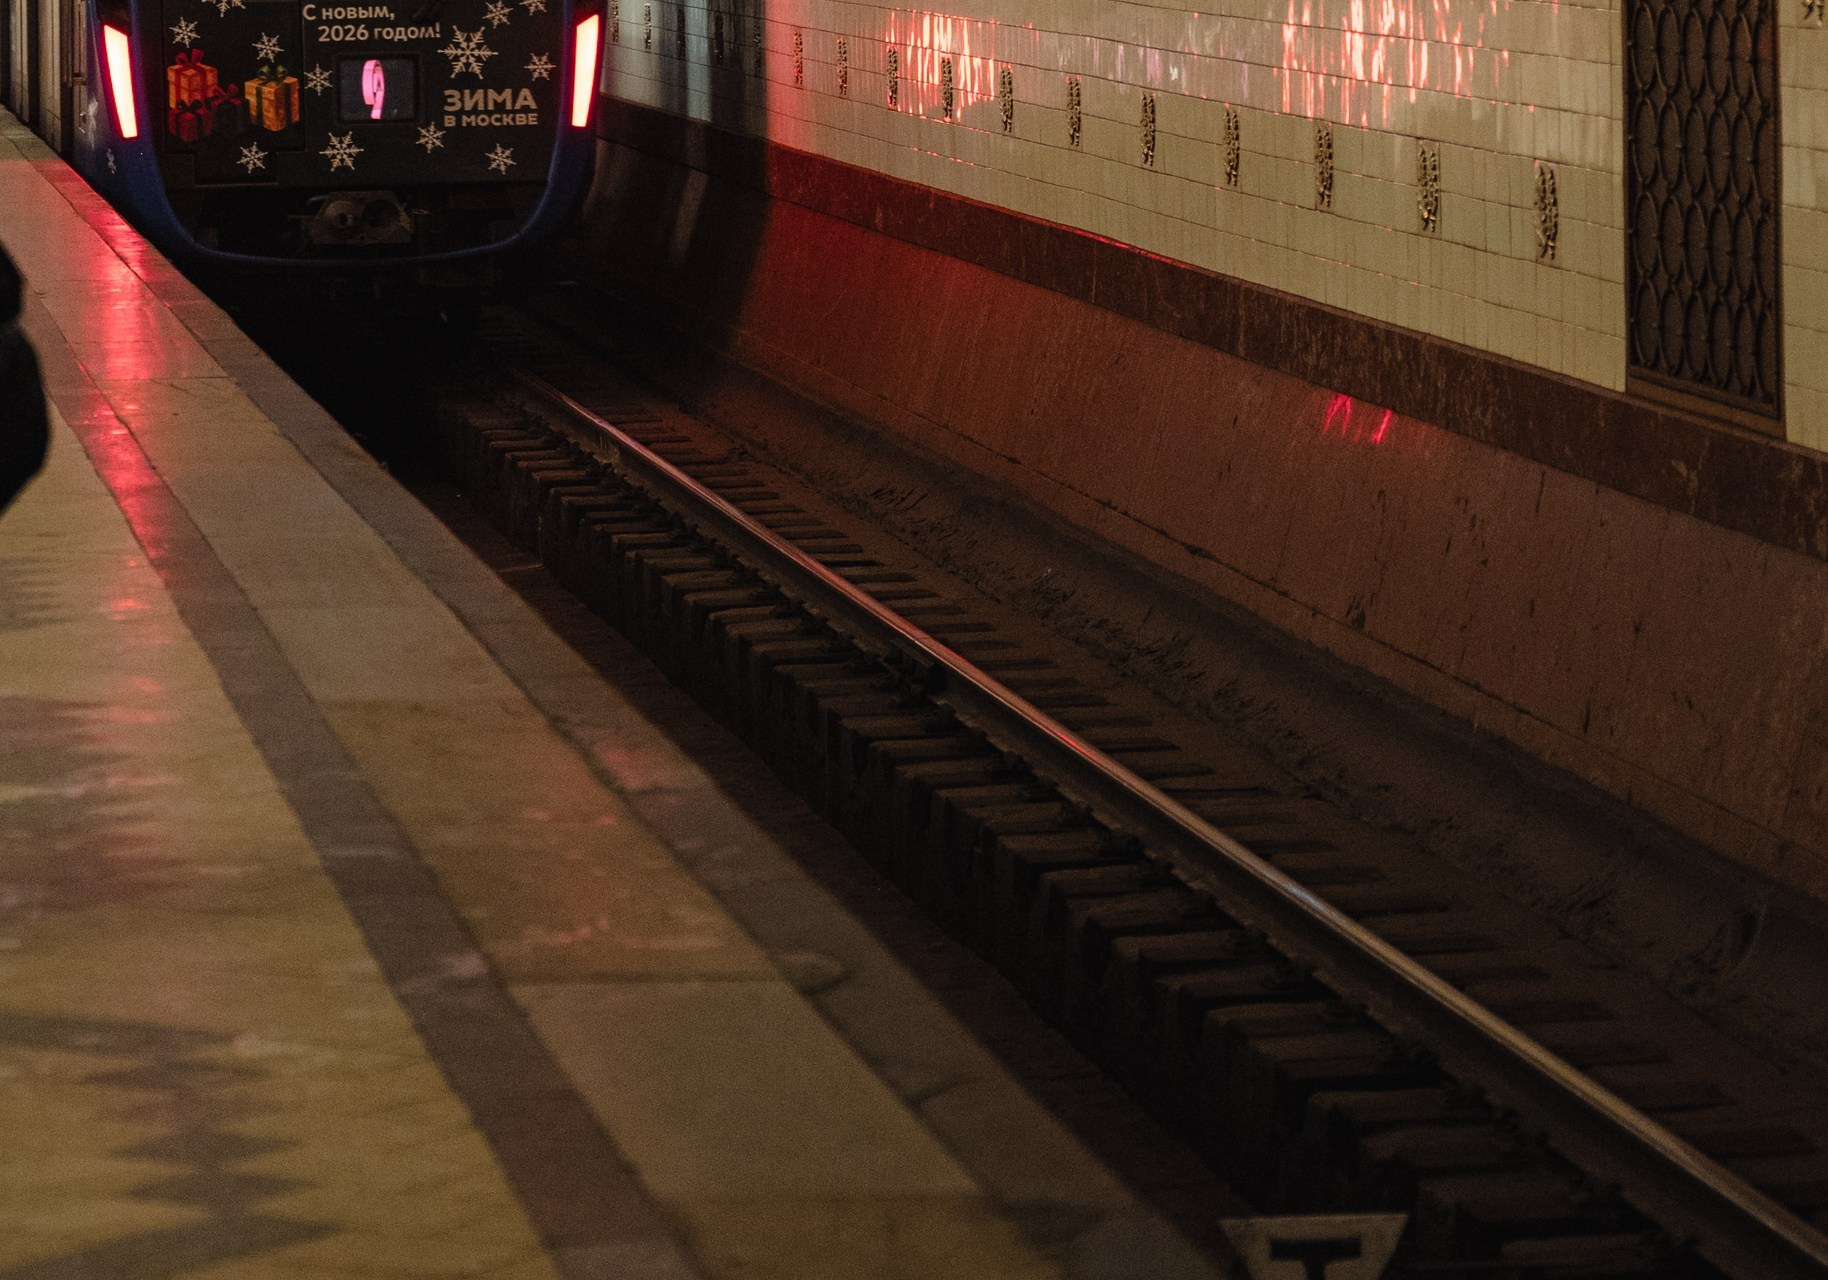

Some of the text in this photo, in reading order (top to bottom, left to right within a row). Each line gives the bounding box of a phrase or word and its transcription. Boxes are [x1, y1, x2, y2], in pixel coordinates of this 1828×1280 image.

[302, 4, 395, 20] С новым,
[318, 22, 441, 42] 2026 годом!
[443, 88, 538, 111] ЗИМА
[444, 113, 539, 127] В МОСКВЕ
